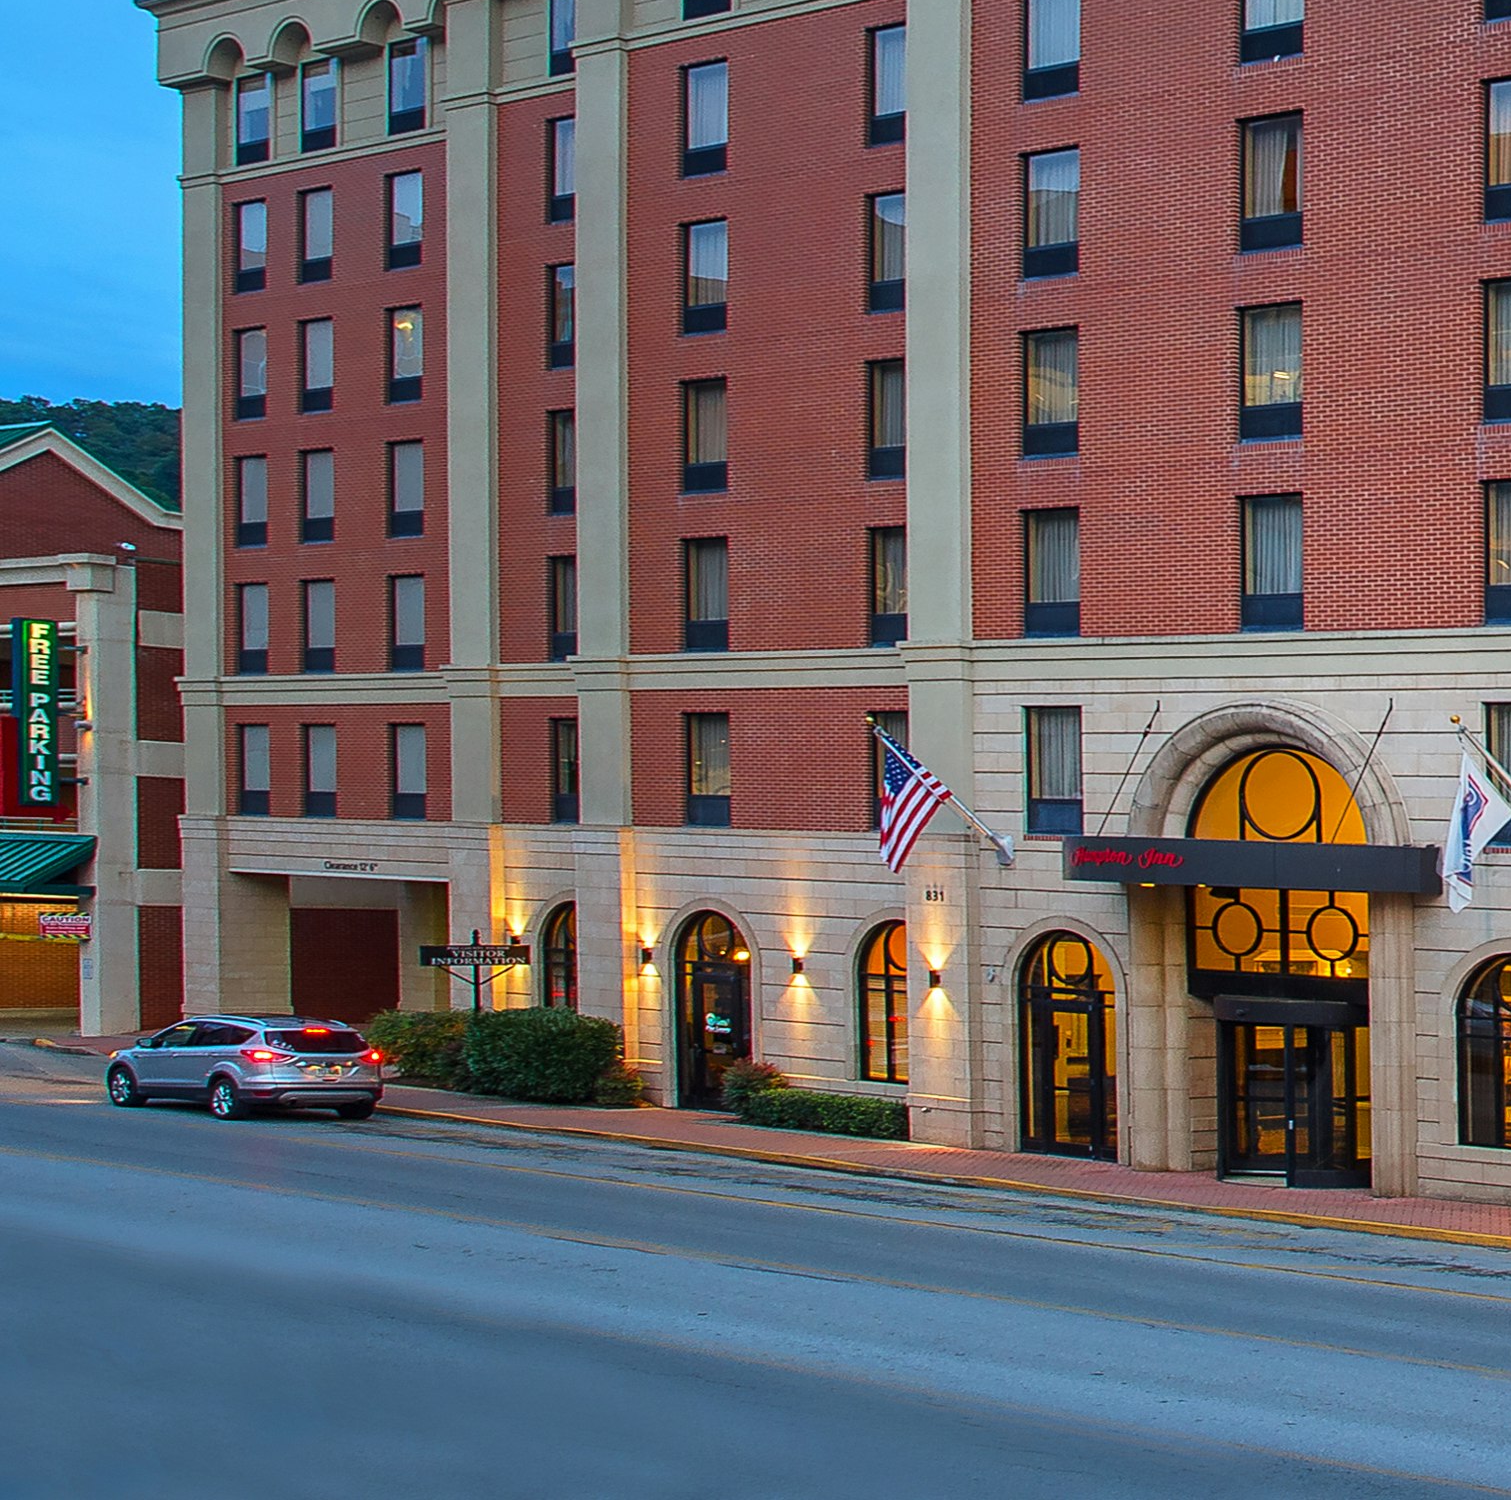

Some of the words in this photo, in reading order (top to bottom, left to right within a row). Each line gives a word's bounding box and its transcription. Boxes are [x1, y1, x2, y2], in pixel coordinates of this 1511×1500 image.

[29, 622, 51, 686] FREE
[29, 692, 52, 802] PARKING
[1070, 846, 1133, 867] Hampton
[1137, 847, 1184, 869] Inn
[925, 890, 945, 901] 831
[431, 957, 526, 965] INFORMATION
[452, 950, 506, 958] VISITOR
